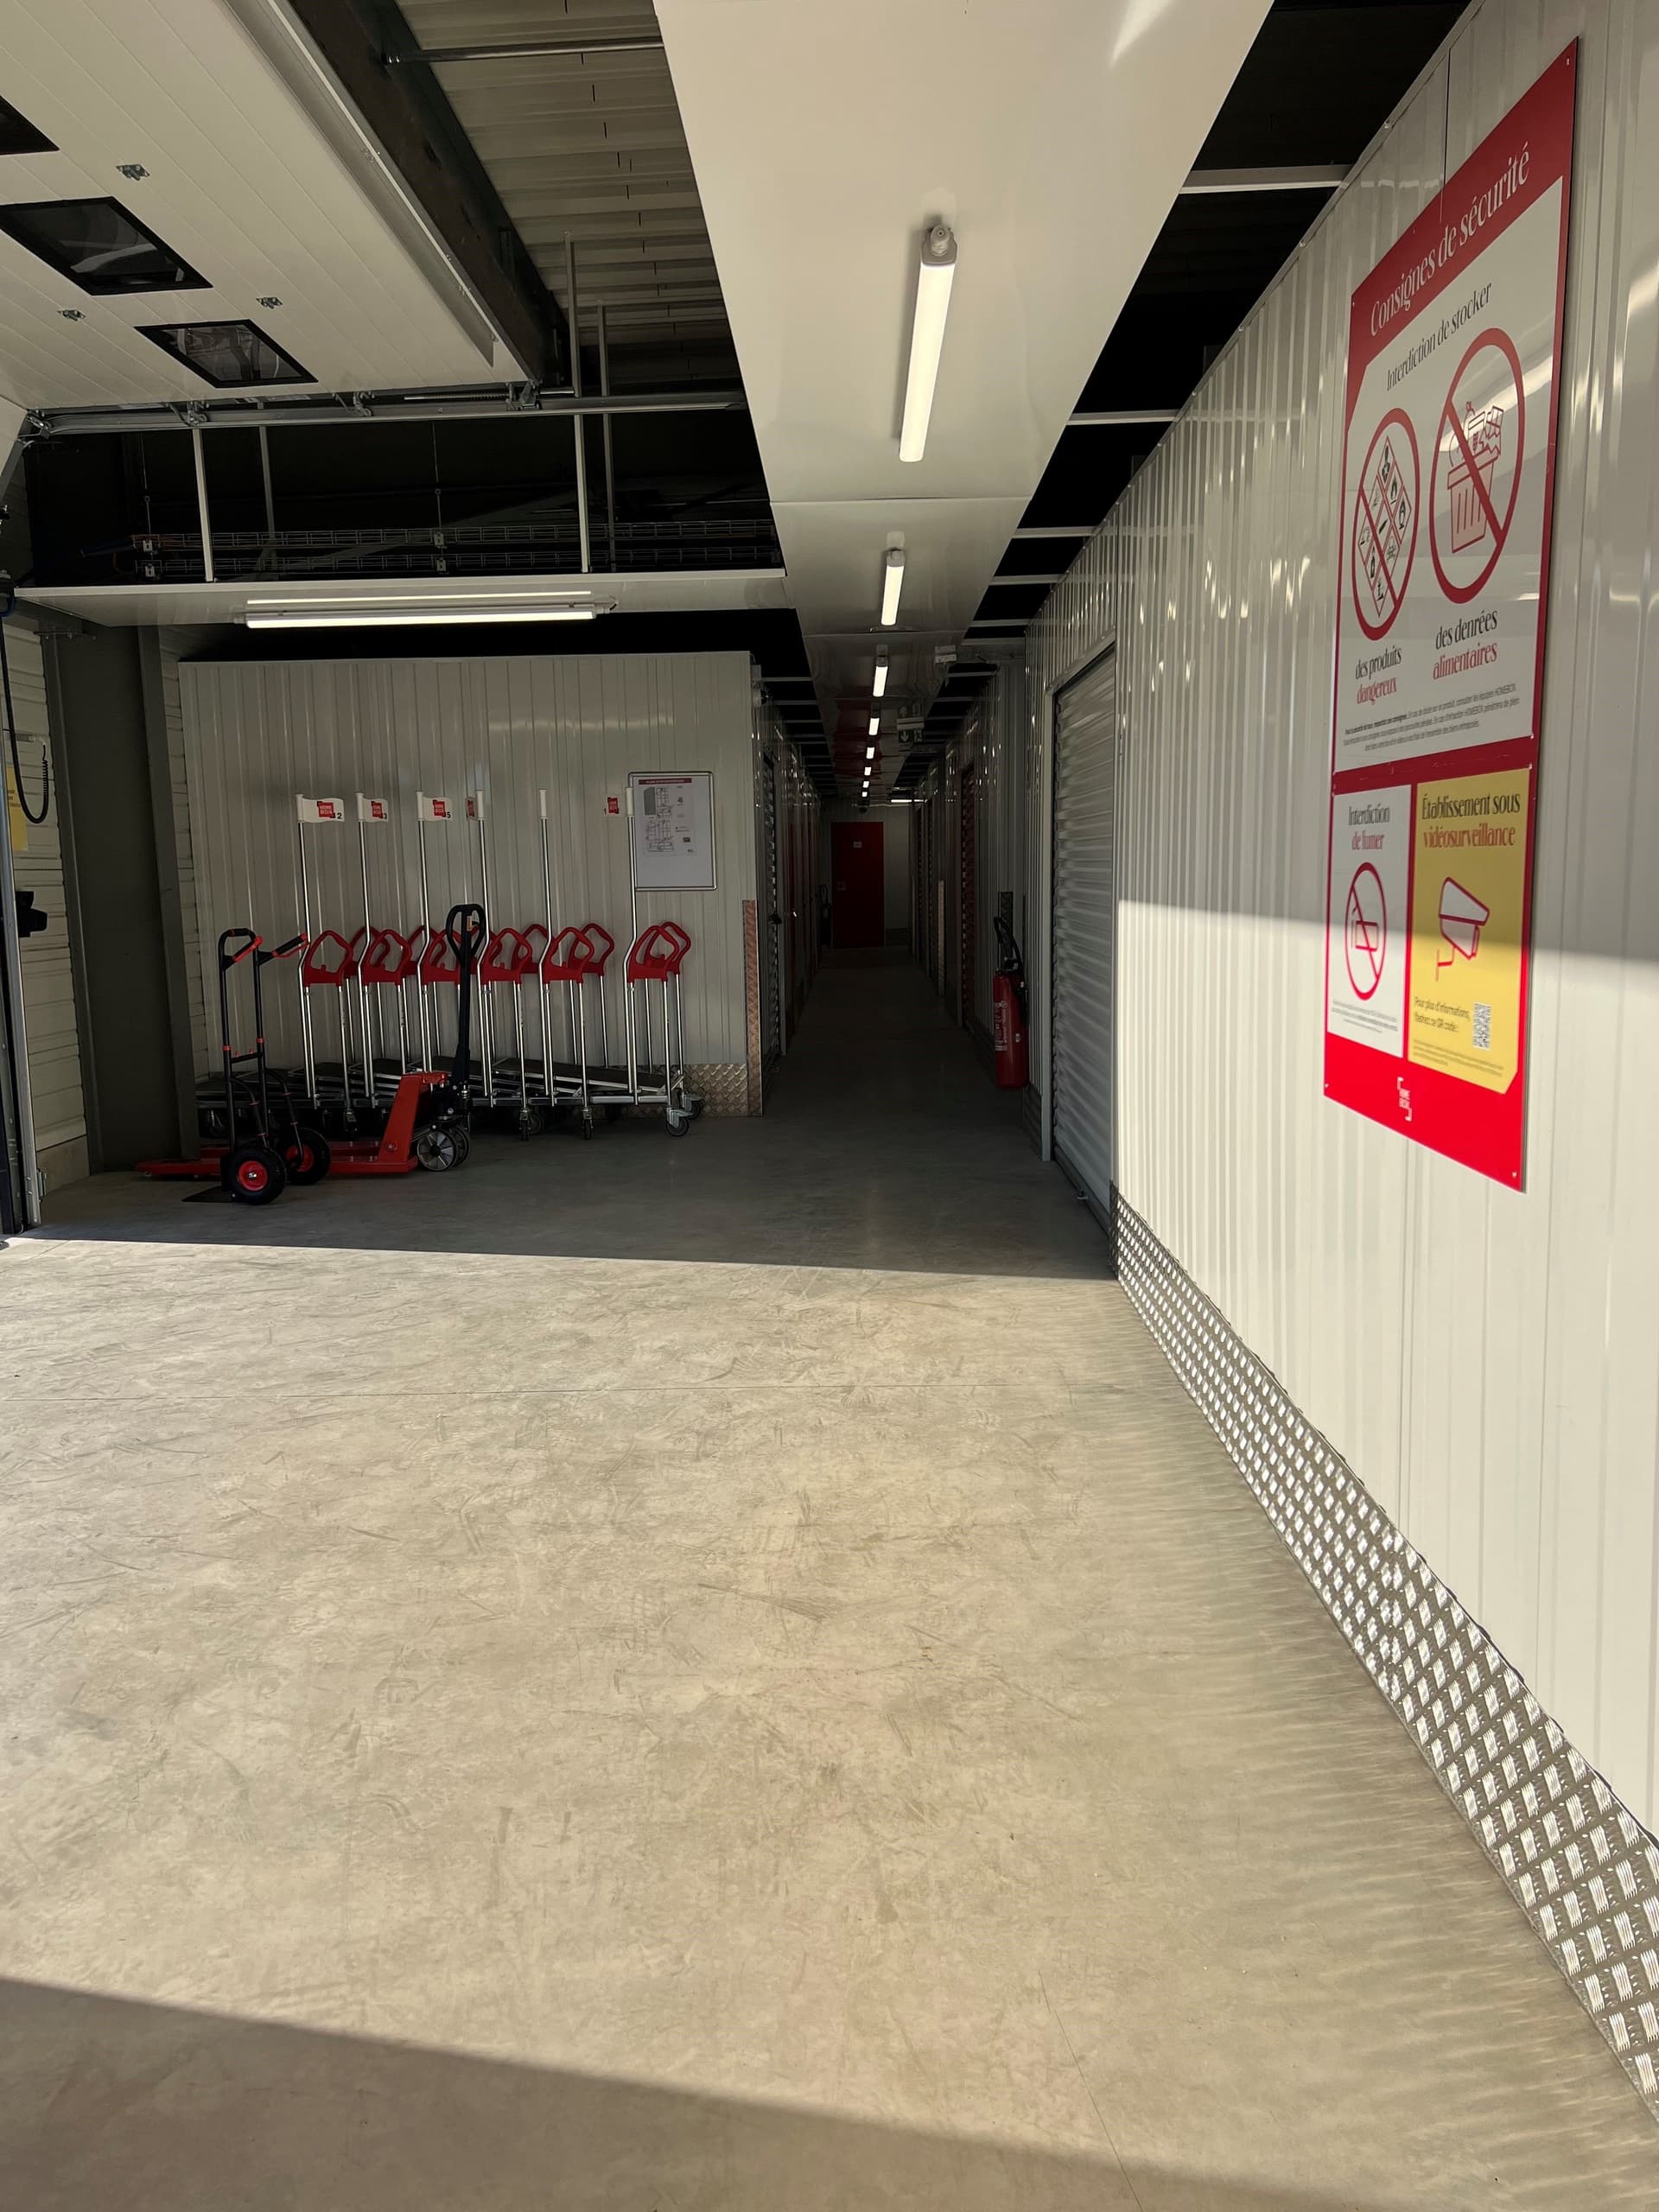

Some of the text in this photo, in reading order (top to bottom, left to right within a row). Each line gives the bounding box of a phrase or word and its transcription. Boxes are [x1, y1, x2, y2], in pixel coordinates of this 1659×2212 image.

[1370, 141, 1529, 336] Consignes de sécurité
[1387, 283, 1491, 391] Interdiction de stocker
[1435, 610, 1497, 650] des denrées
[1355, 645, 1402, 680] des produits
[1433, 642, 1497, 680] alimentaires
[1357, 677, 1396, 705] dangereux
[1348, 803, 1390, 826] Interdiction
[1421, 792, 1521, 820] Établissement sous
[1351, 831, 1360, 850] de
[1423, 823, 1516, 849] vidéosurveillance
